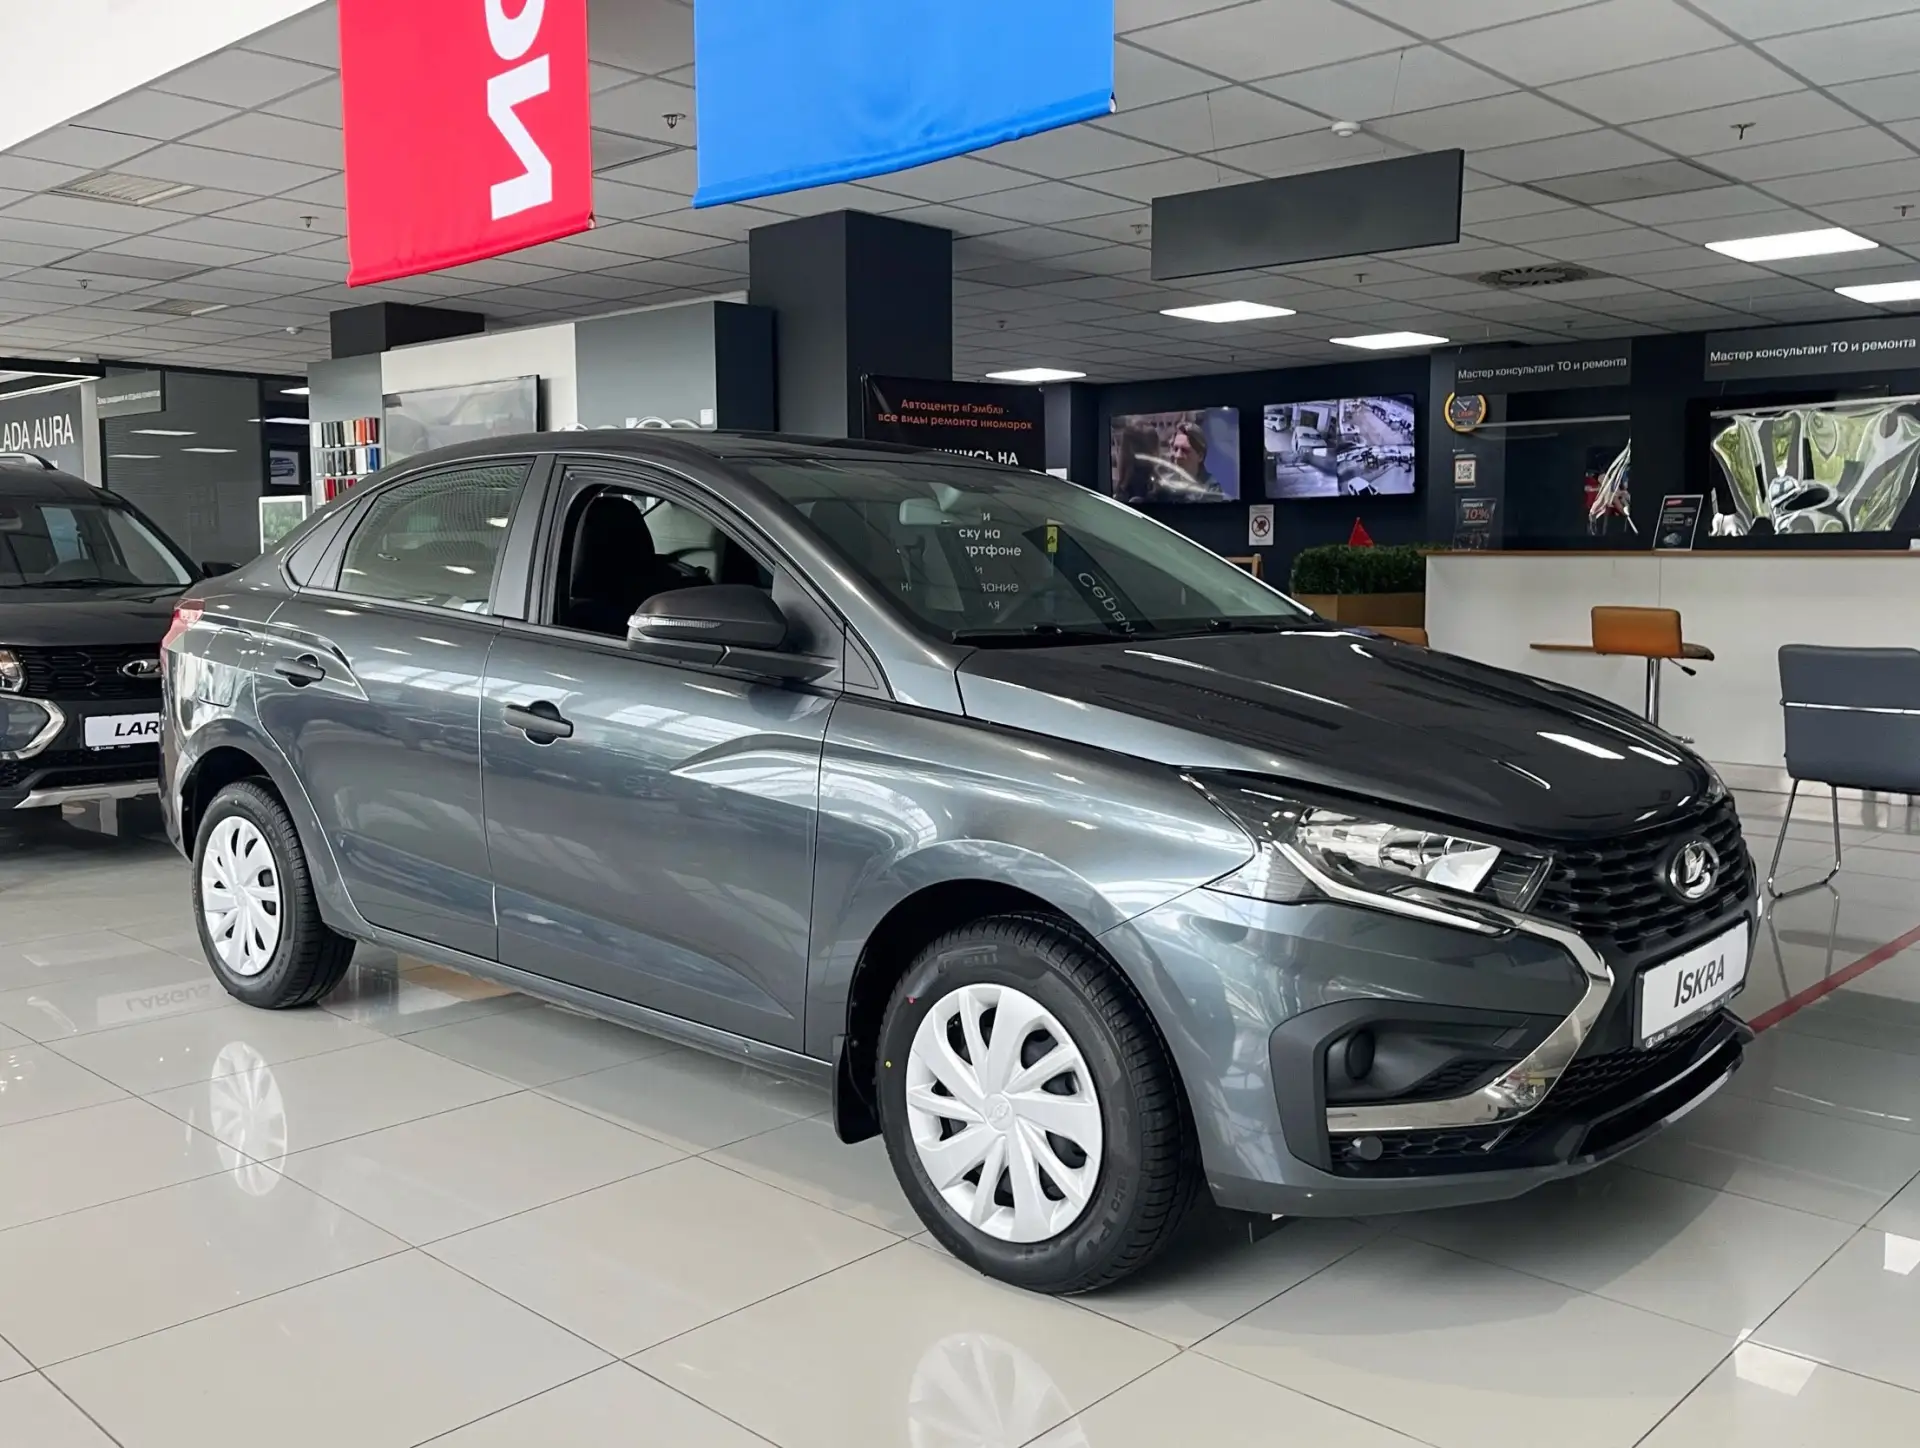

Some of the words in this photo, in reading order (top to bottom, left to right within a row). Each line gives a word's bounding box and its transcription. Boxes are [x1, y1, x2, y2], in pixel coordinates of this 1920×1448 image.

[1710, 350, 1753, 362] Мастер
[1756, 344, 1828, 358] консультант
[1831, 341, 1848, 353] ТО
[1851, 343, 1859, 352] и
[1862, 338, 1916, 353] ремонта
[1458, 367, 1494, 380] Мастер
[1495, 363, 1554, 377] консультант
[1557, 361, 1571, 372] ТО
[1573, 362, 1580, 370] и
[1582, 357, 1627, 370] ремонта
[901, 399, 960, 413] Автоцентр
[878, 413, 898, 423] все
[901, 416, 928, 425] виды
[930, 418, 978, 428] ремонта
[980, 420, 1033, 430] иномарок
[0, 421, 31, 452] ADA
[34, 413, 75, 450] AURA
[998, 452, 1019, 466] НА
[958, 528, 981, 541] ску
[984, 528, 1001, 539] на
[115, 721, 159, 737] LAR
[1674, 954, 1725, 1008] ISKRA
